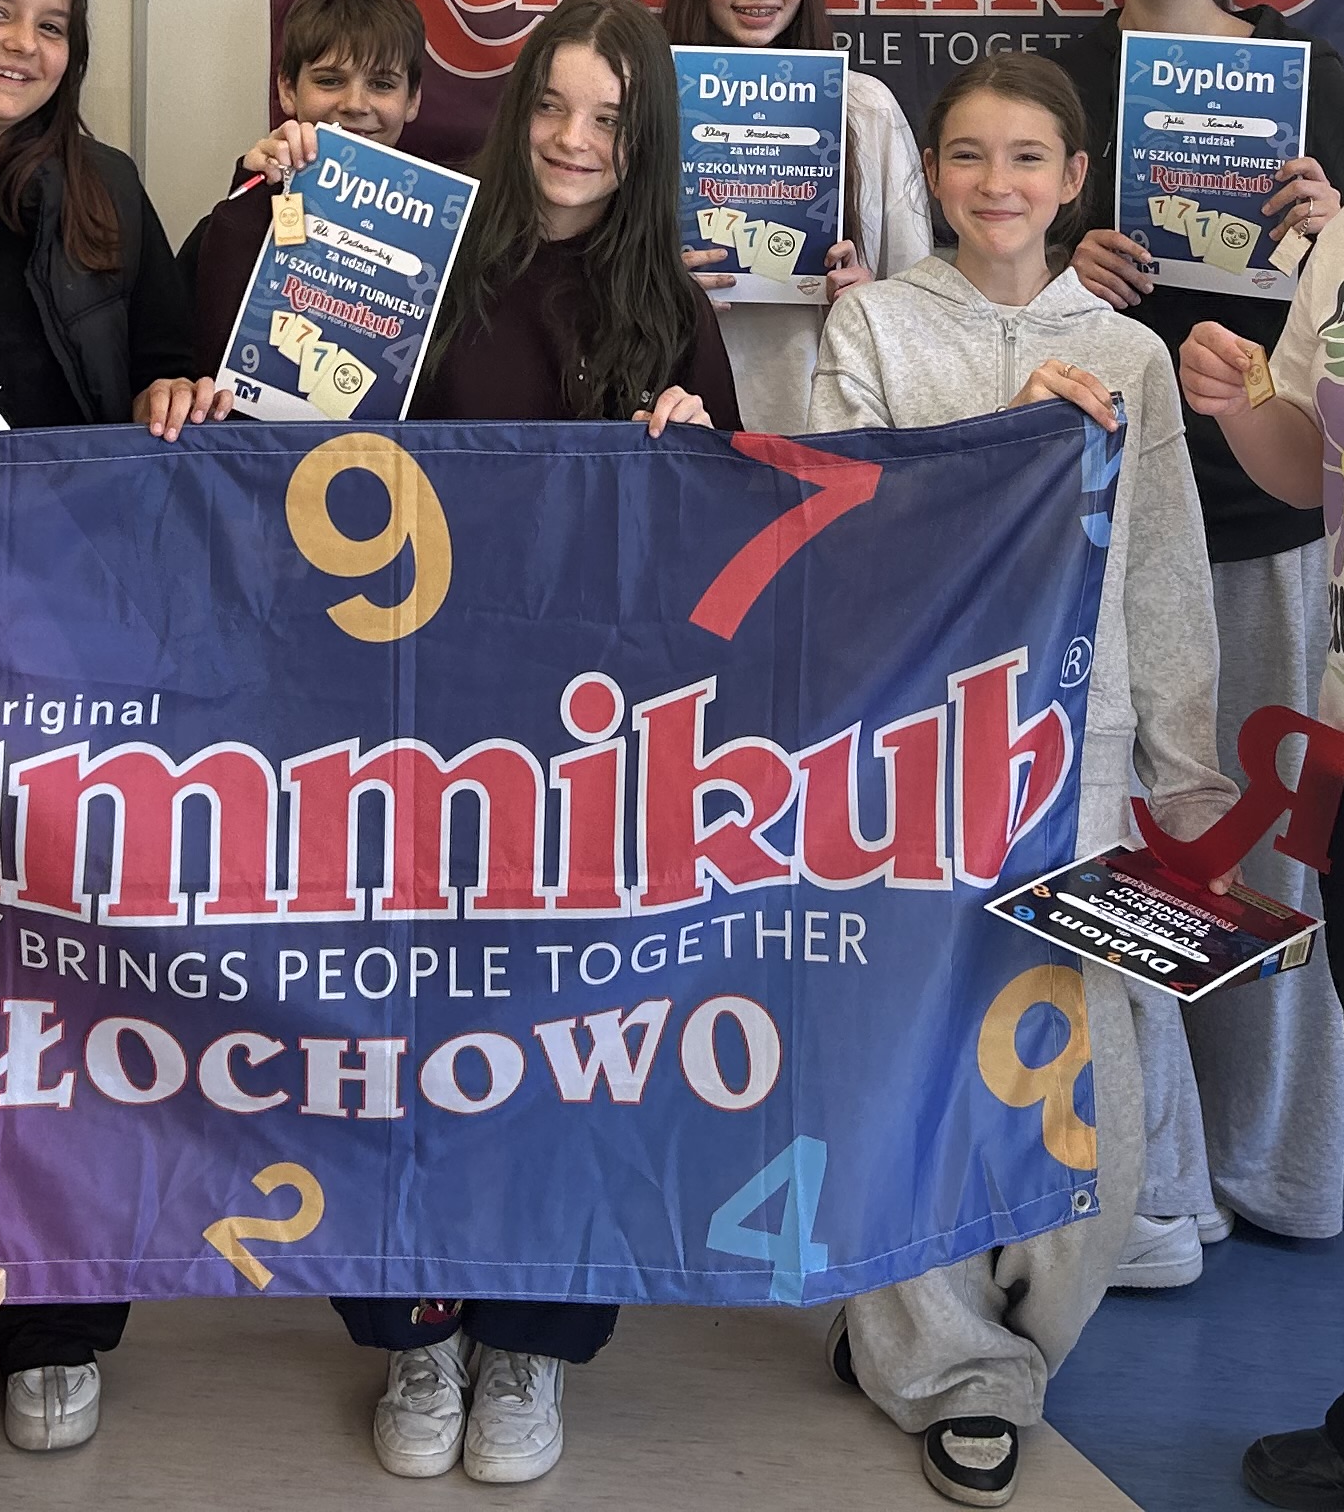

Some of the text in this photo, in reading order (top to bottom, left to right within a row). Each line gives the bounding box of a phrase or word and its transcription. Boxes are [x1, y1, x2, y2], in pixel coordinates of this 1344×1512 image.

[699, 74, 816, 107] Dyplom
[1152, 60, 1275, 95] Dyplom
[730, 145, 781, 157] za udział
[1133, 148, 1287, 170] W SZKOLNYM TURNIEJ
[1182, 135, 1236, 148] za udział
[317, 157, 434, 229] Dyplom
[682, 162, 834, 178] W SZKOLNYM TURNIEJU
[699, 177, 817, 205] Rummikub
[1150, 165, 1274, 195] Rummikub
[274, 250, 425, 321] W SZKOLNYM TURNIEJU
[325, 249, 377, 278] za udział
[281, 275, 402, 340] Rummikub
[285, 433, 452, 642] 9
[687, 431, 885, 643] 7
[17, 910, 870, 1002] BRINGS PEOPLE TOGETHER
[1049, 909, 1178, 975] Dyplom
[201, 1163, 327, 1291] 2
[707, 1139, 830, 1306] 4
